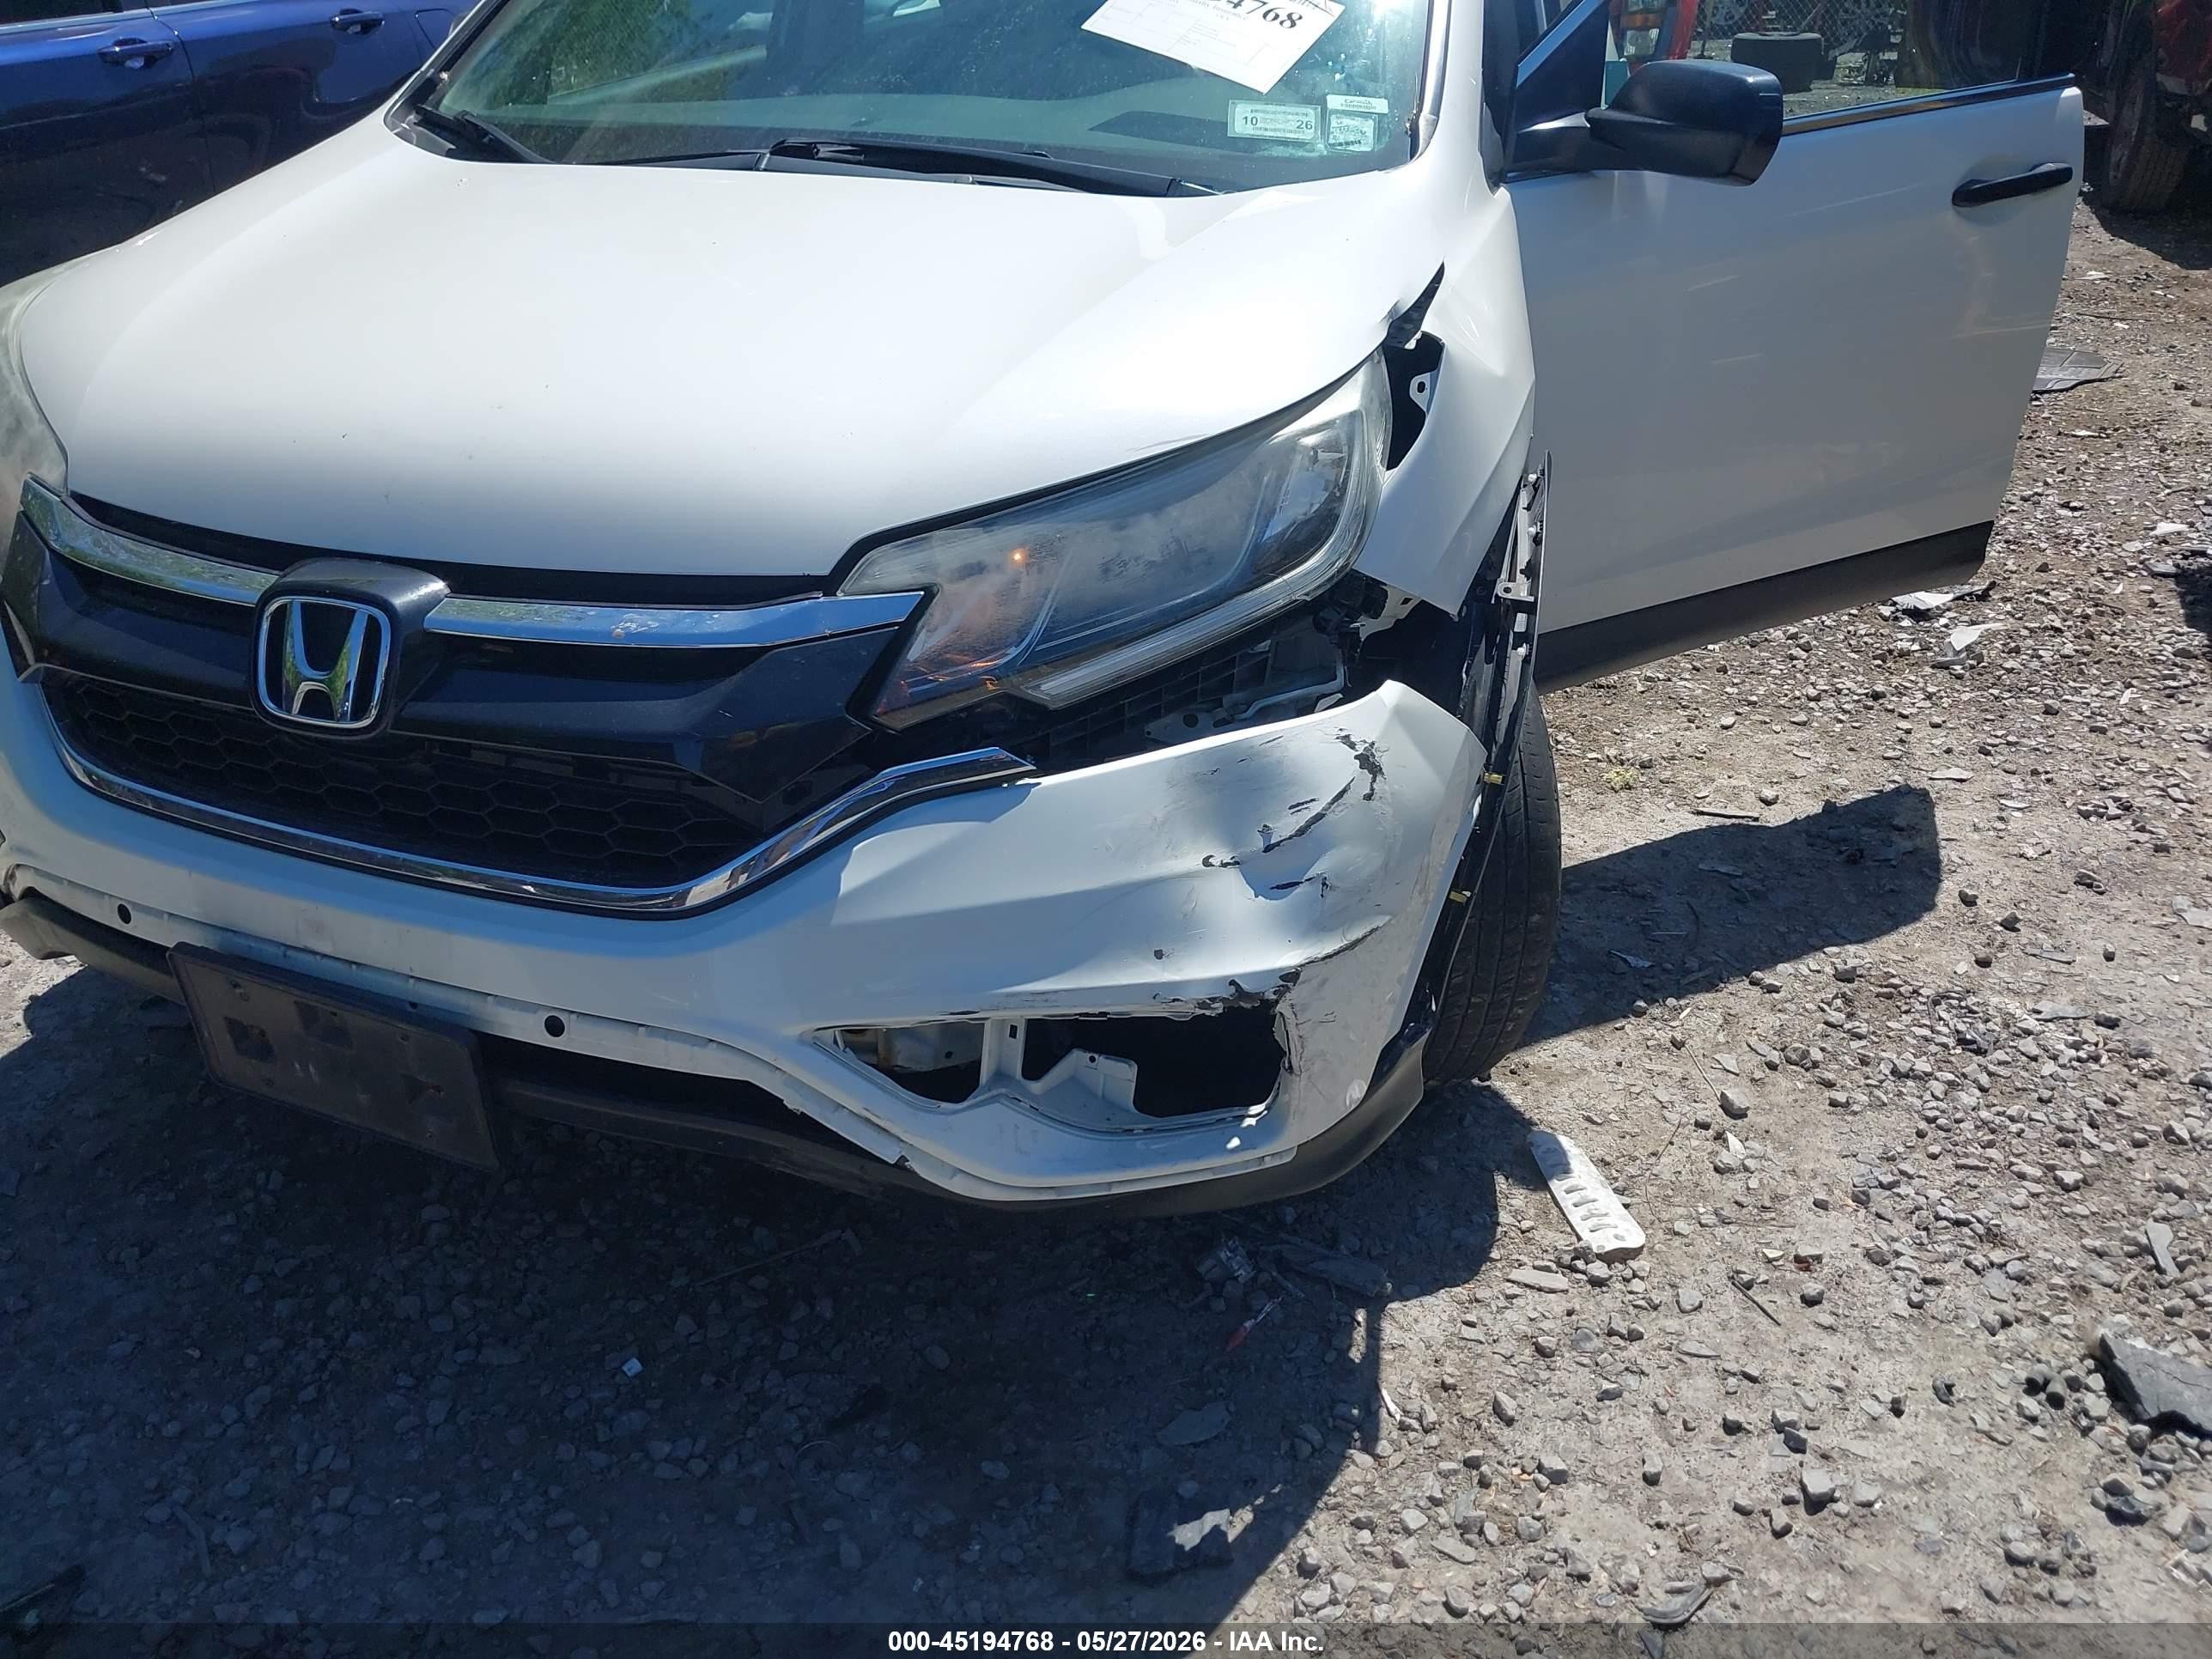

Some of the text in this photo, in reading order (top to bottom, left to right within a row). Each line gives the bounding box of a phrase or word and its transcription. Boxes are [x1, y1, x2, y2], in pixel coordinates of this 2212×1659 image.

[1209, 0, 1304, 29] 4768
[1243, 115, 1259, 126] 10
[1296, 119, 1314, 131] 26
